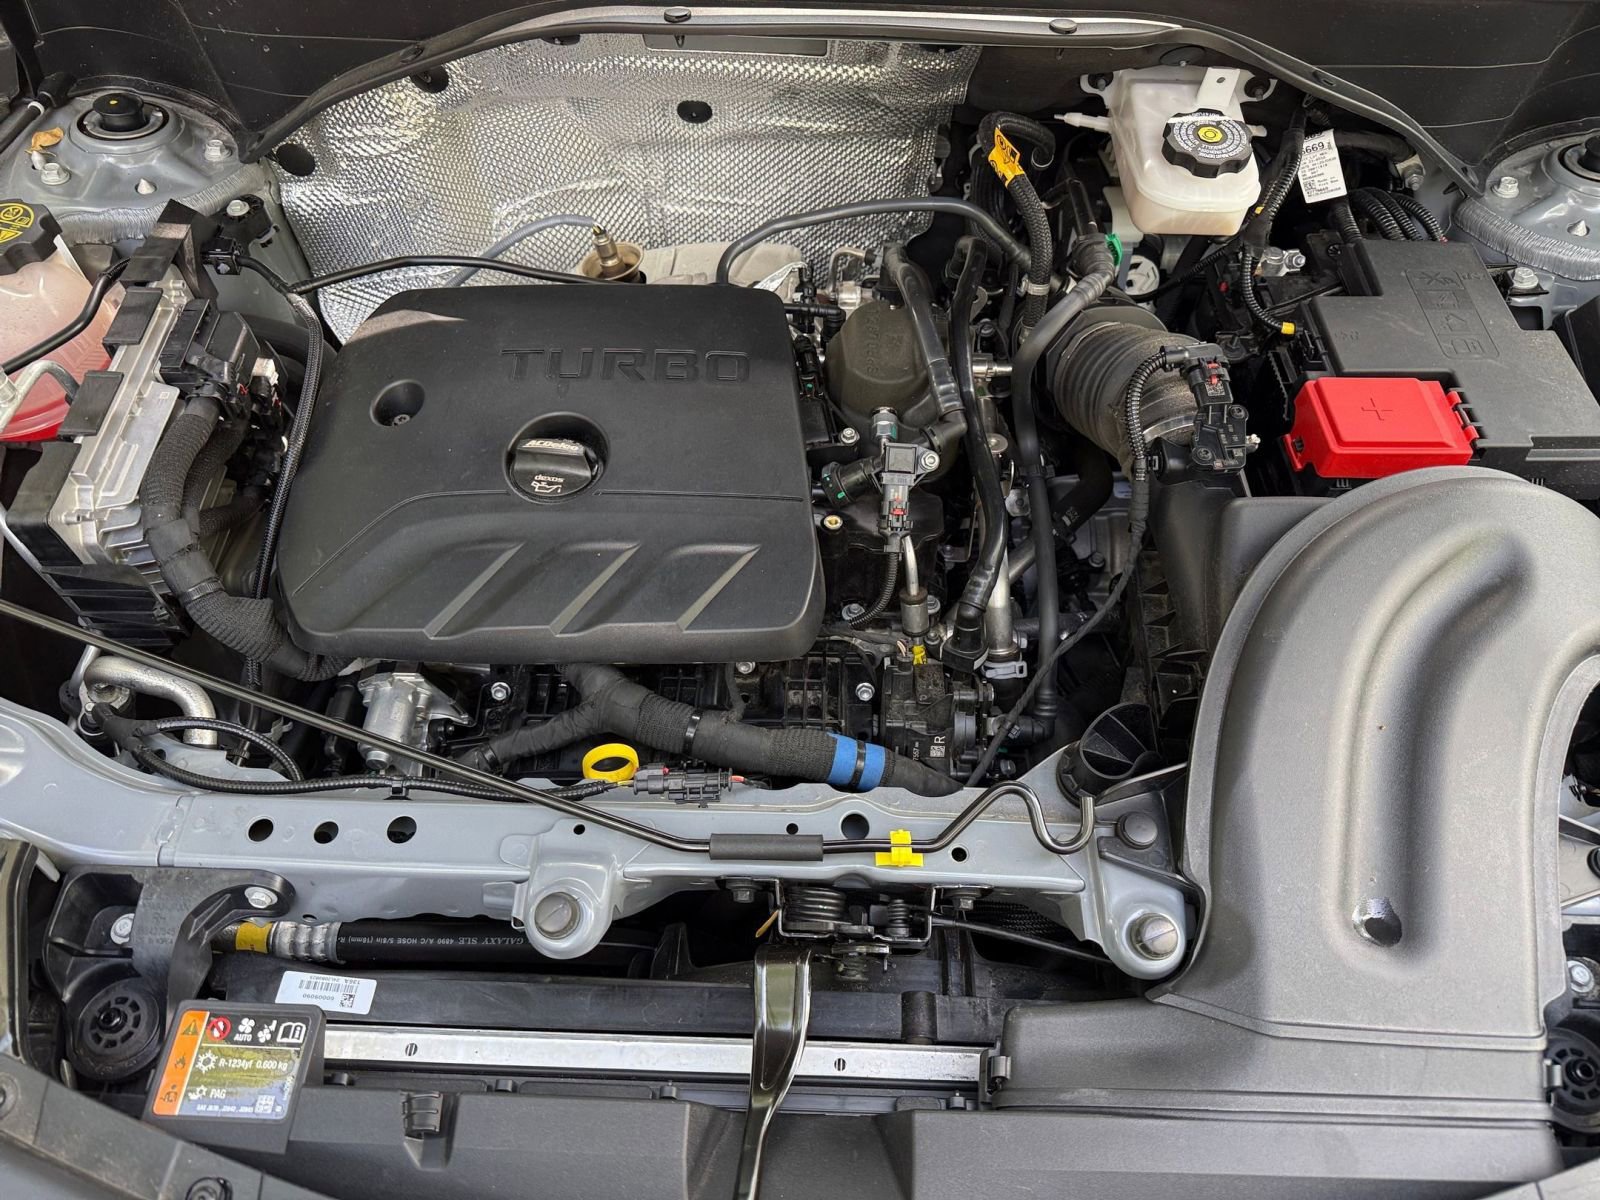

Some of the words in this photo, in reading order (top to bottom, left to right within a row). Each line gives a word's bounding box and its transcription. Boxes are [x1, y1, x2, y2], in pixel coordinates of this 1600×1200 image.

[501, 348, 750, 382] TURBO
[522, 440, 579, 450] ACDelco
[534, 474, 565, 482] dexos
[458, 937, 478, 945] SLE
[482, 937, 524, 945] GALAXY
[234, 1033, 253, 1042] AUTO
[219, 1057, 254, 1070] R-1234yf
[256, 1060, 277, 1070] 0.600
[277, 1061, 288, 1071] kg
[209, 1088, 227, 1099] PAG
